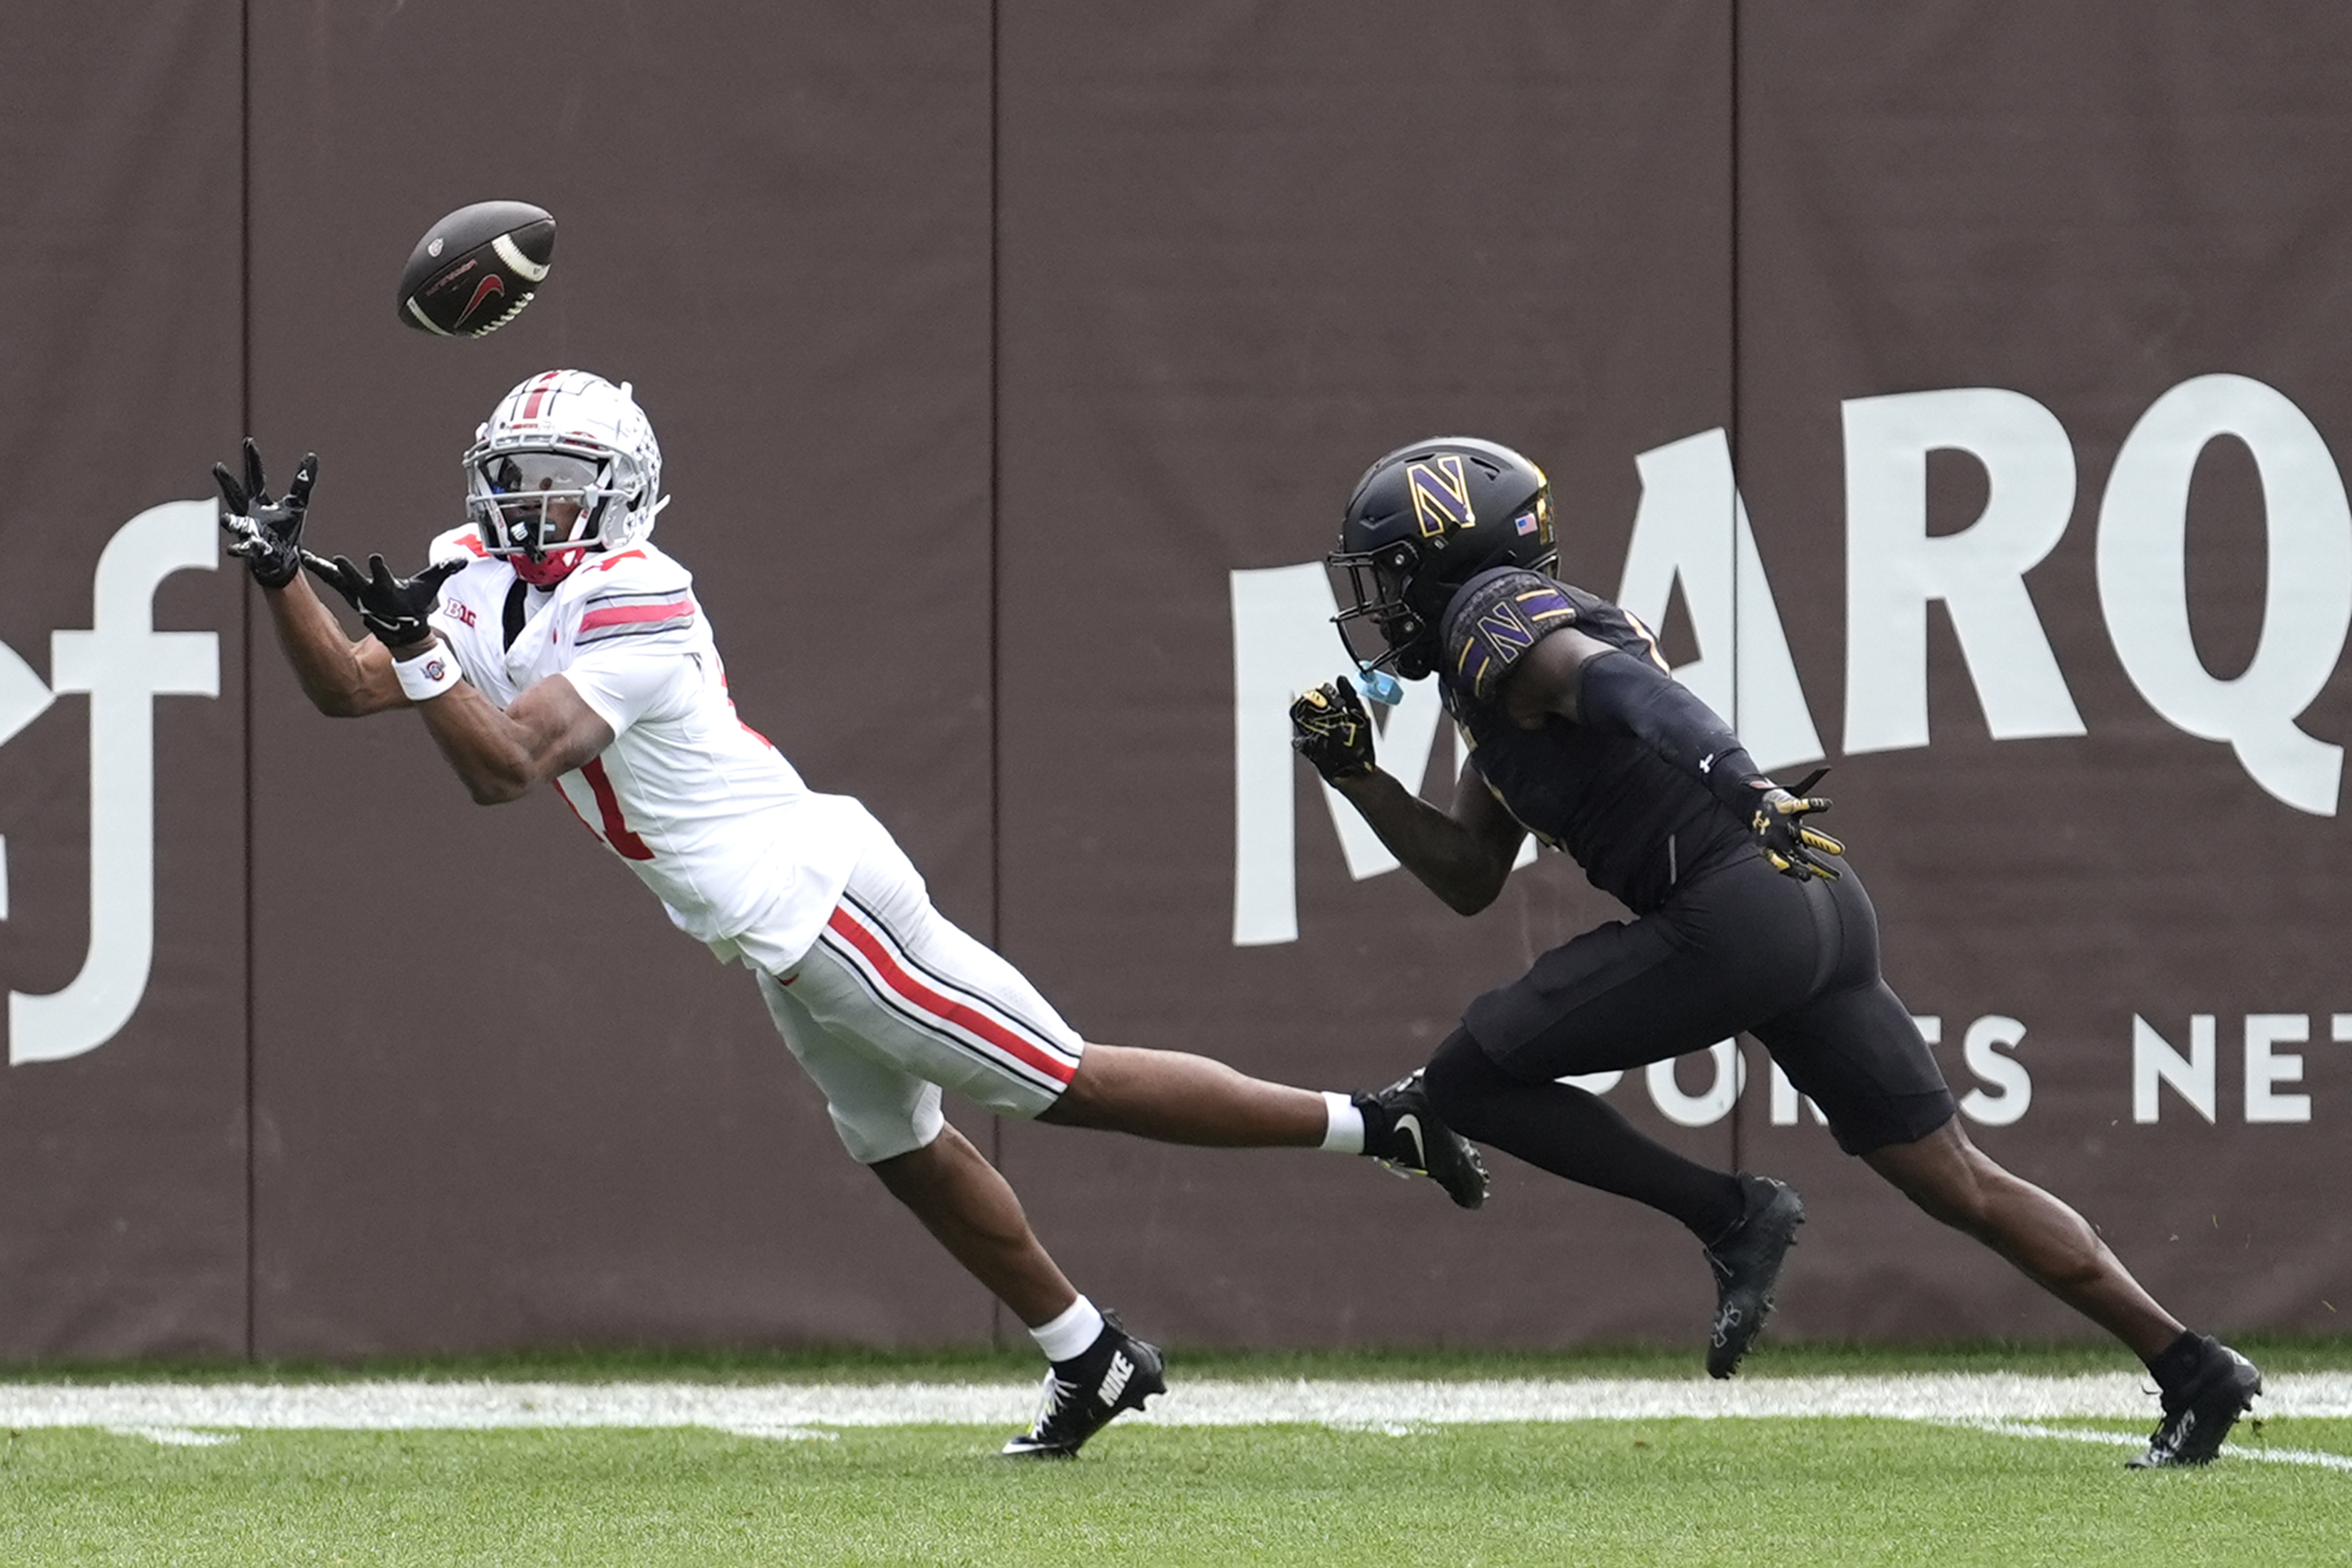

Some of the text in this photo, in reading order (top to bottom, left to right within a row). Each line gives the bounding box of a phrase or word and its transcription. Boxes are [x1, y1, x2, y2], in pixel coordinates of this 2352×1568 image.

[1406, 456, 1475, 537] N
[1477, 602, 1534, 664] N
[0, 495, 220, 1066] f
[1098, 1350, 1135, 1408] NIKE
